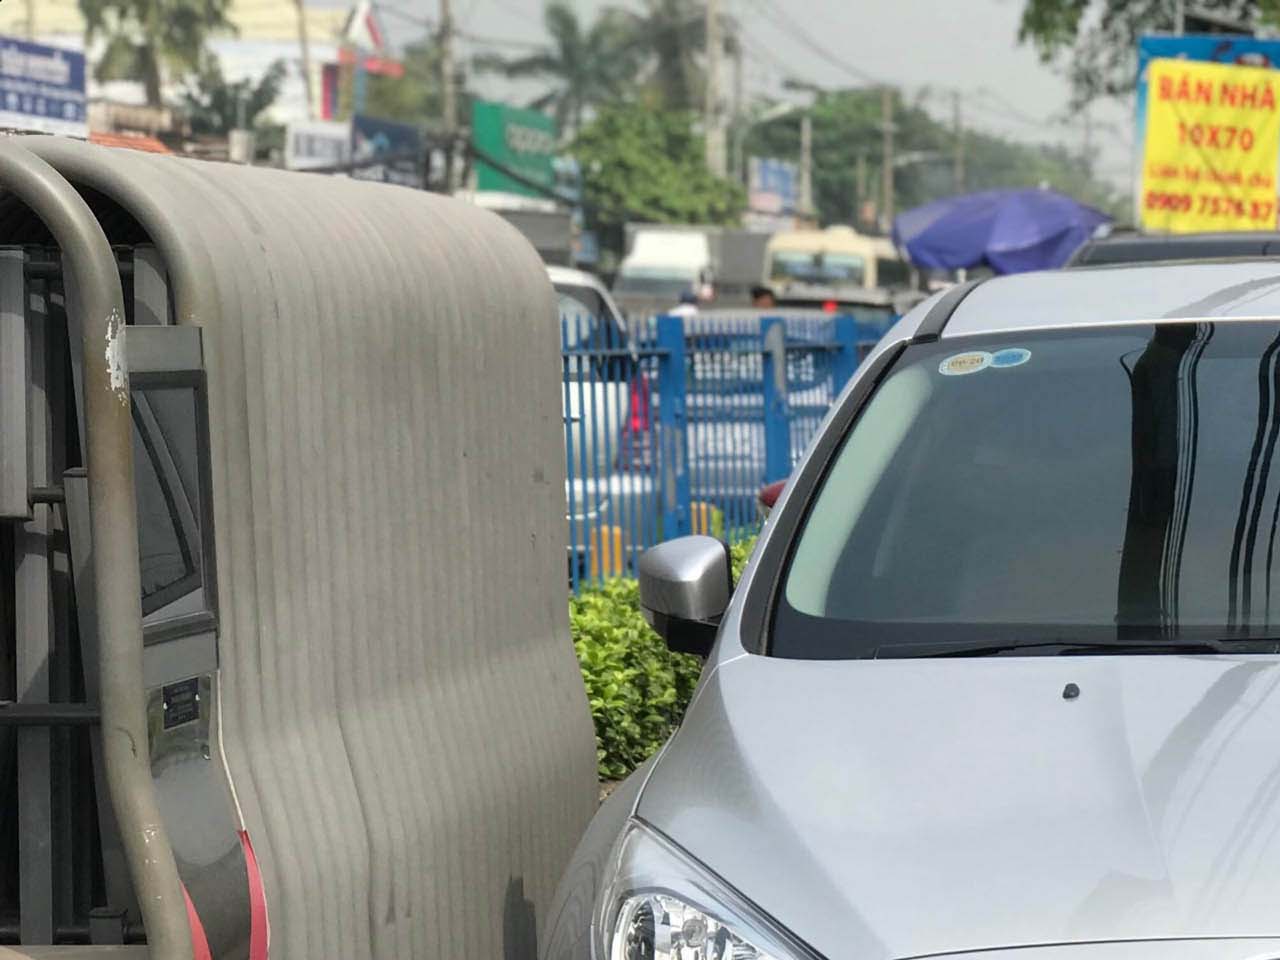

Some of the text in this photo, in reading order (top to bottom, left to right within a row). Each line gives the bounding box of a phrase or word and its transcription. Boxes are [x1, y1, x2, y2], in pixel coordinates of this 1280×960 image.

[1158, 74, 1277, 114] BÁN NHÀ
[1178, 121, 1254, 152] 10X70
